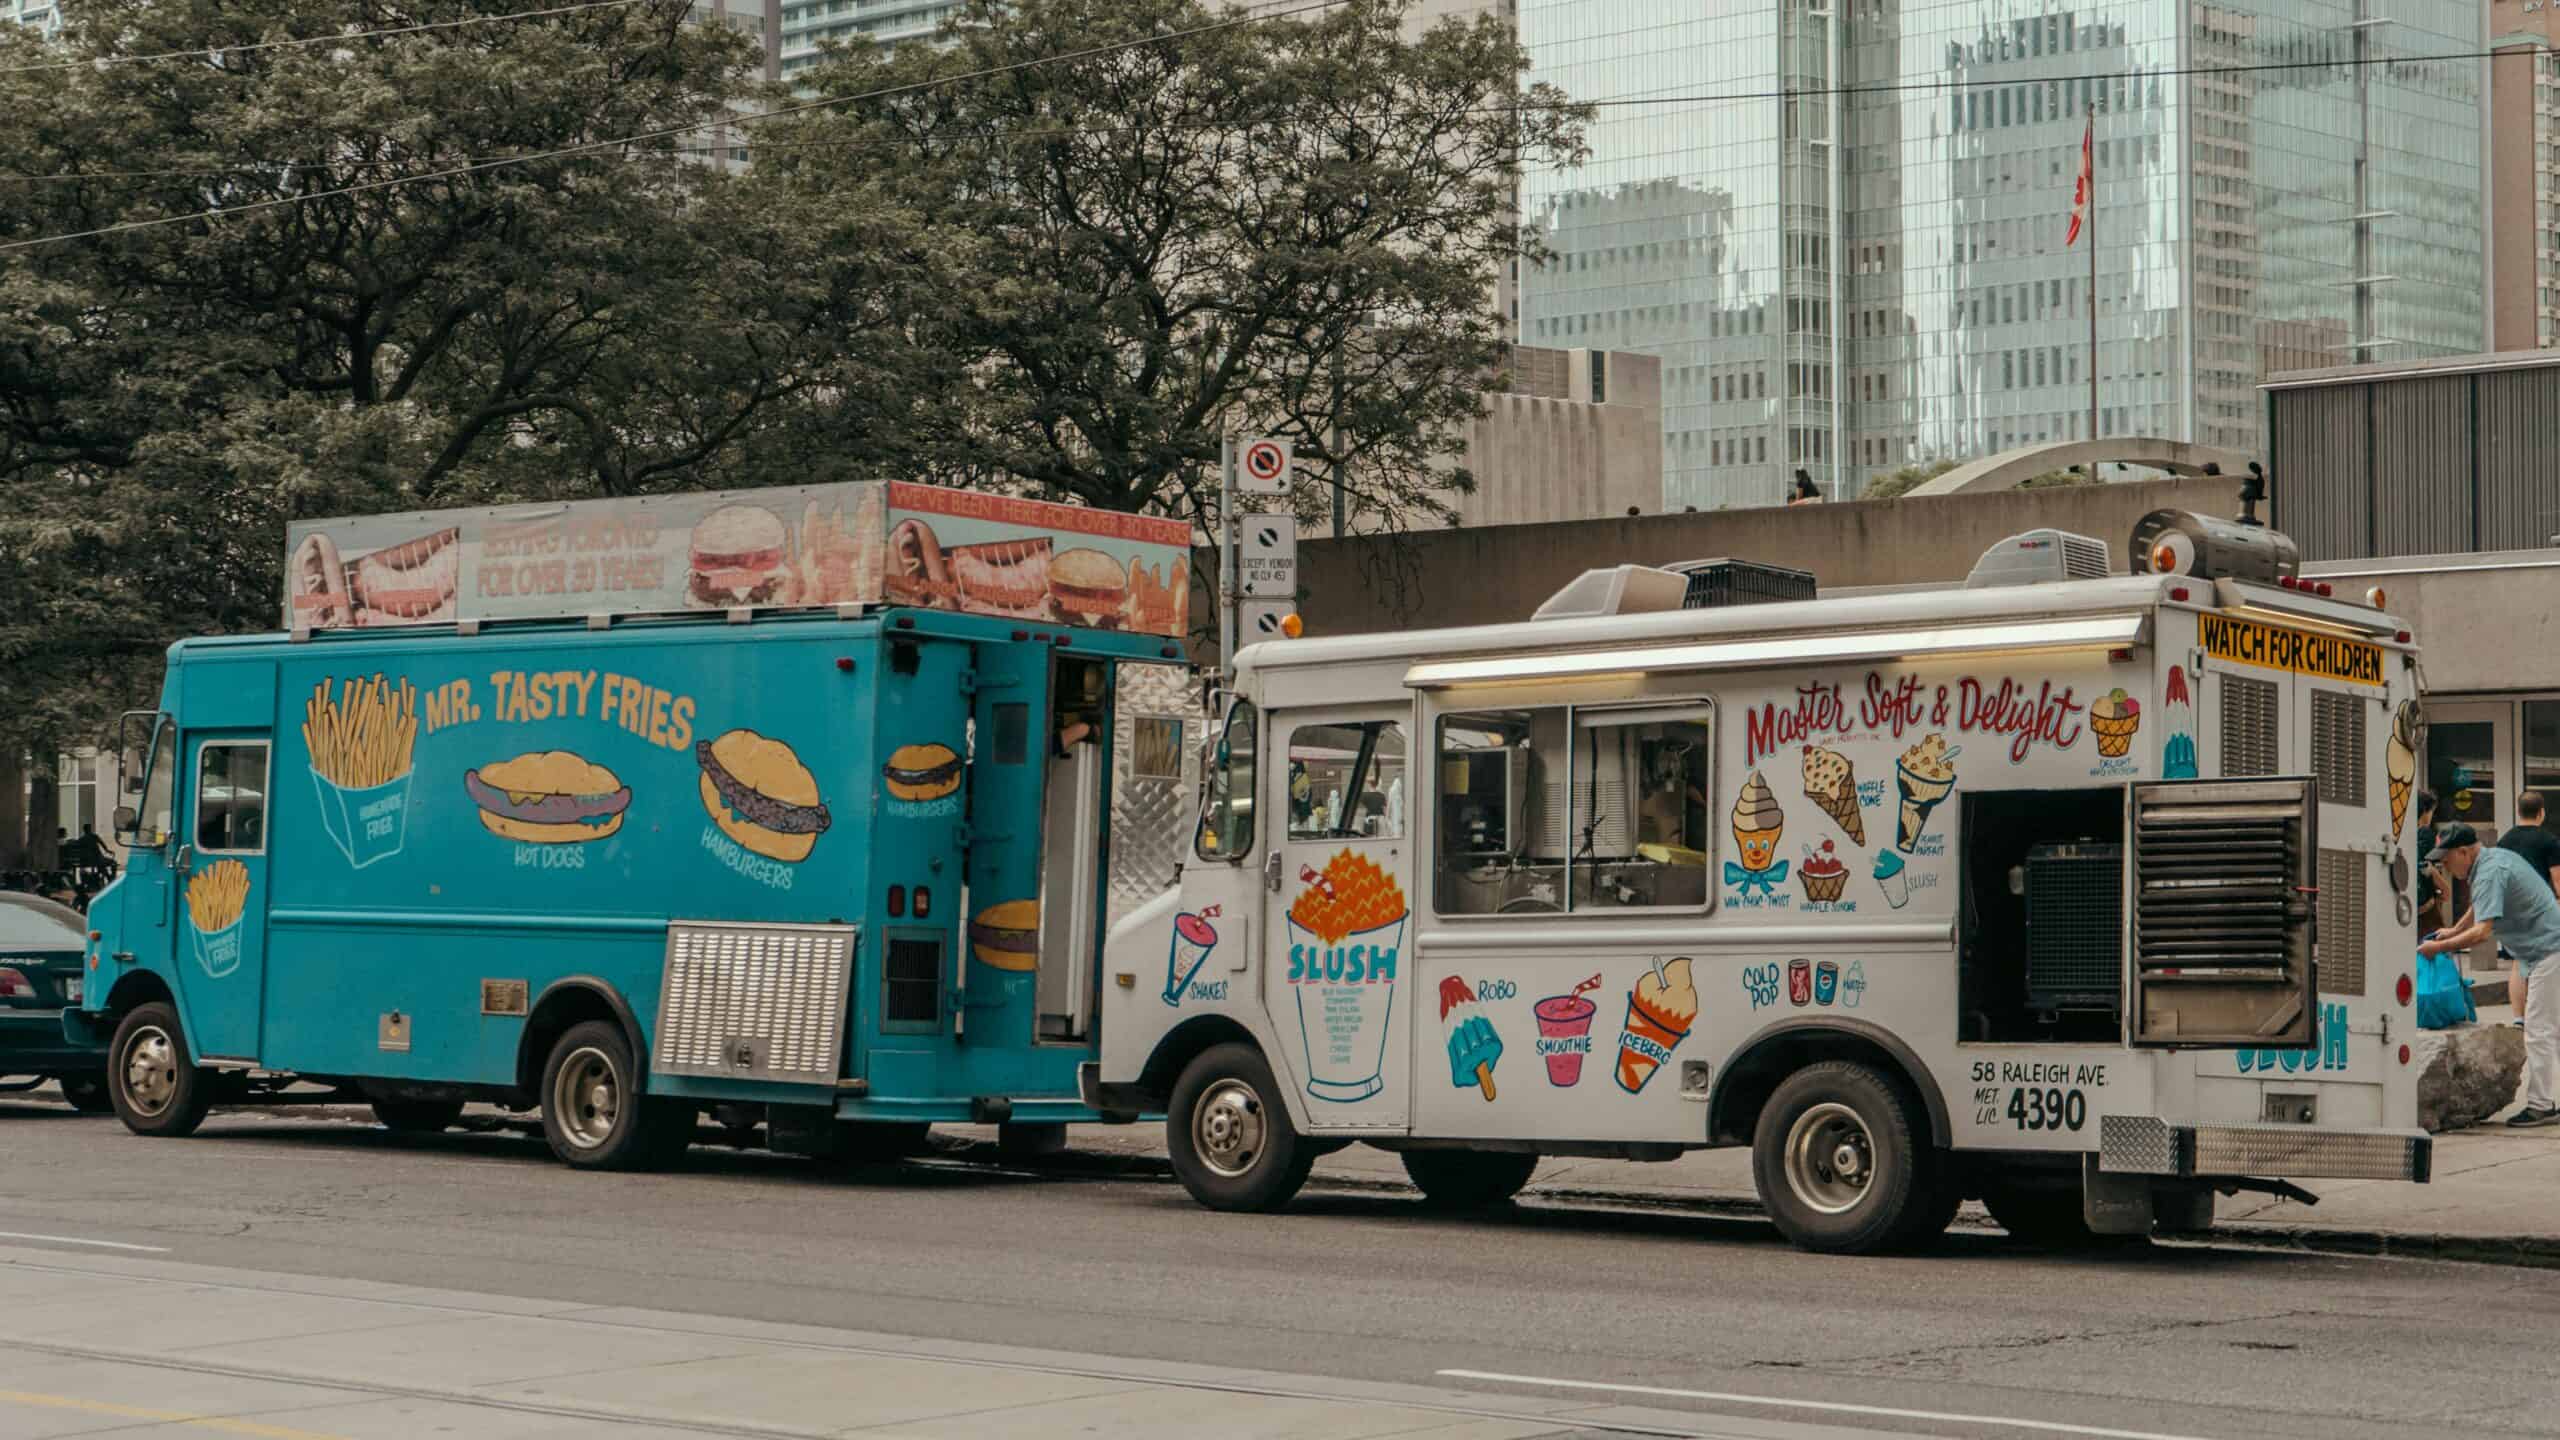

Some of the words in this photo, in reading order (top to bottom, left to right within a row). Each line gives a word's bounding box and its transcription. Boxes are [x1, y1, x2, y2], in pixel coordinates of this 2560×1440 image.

[895, 487, 946, 511] WE'VE
[951, 492, 993, 516] BEEN
[1000, 500, 1042, 523] HERE
[1048, 506, 1074, 527] FOR
[1079, 511, 1119, 532] OVER
[1122, 517, 1141, 536] 30
[1144, 521, 1189, 544] YEARS
[477, 565, 513, 598] FOR
[516, 559, 566, 595] OVER
[571, 557, 597, 593] 30
[2204, 615, 2266, 663] WATCH
[2269, 629, 2304, 669] FOR
[2306, 636, 2382, 682] CHILDREN
[424, 677, 481, 735] MR.
[489, 668, 598, 724] TASTY
[600, 671, 696, 752] FRIES
[1746, 679, 1854, 767] Master
[1860, 670, 1926, 739] Soft
[1931, 684, 1950, 727] &
[1957, 675, 2084, 763] Delight
[514, 844, 540, 868] HOT
[541, 844, 585, 869] DOGS
[701, 825, 793, 890] HAMBURGERS
[1287, 943, 1398, 985] SLUSH
[1742, 962, 1780, 991] COLD
[1188, 980, 1228, 1001] SHAKES
[1750, 984, 1779, 1012] POP
[1536, 1035, 1593, 1057] SMOOTHIE
[1617, 1030, 1672, 1066] ICEBERG
[1970, 1060, 1996, 1082] 58
[2002, 1060, 2070, 1084] RALEIGH
[2007, 1086, 2087, 1133] 4390
